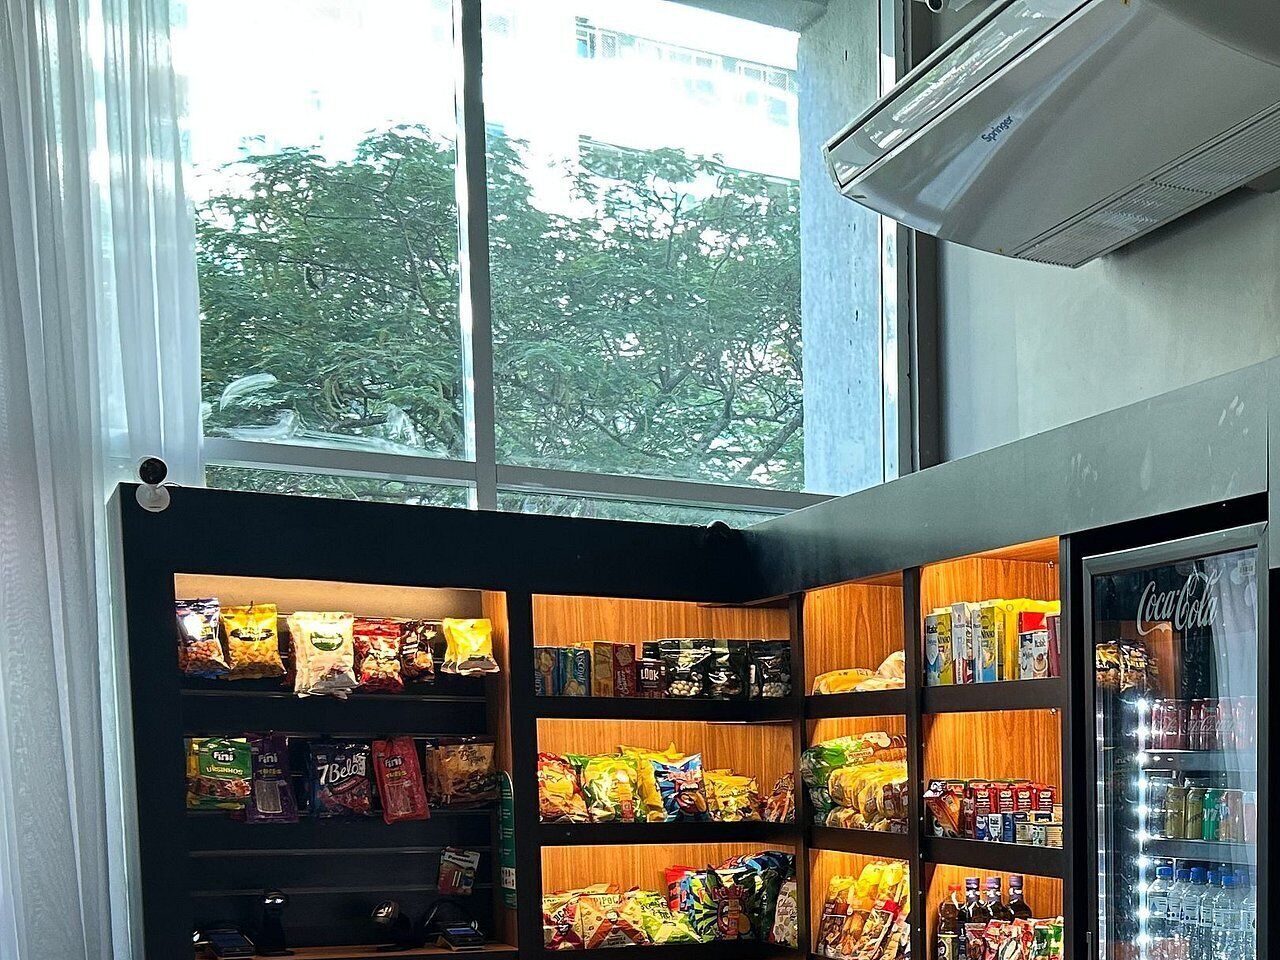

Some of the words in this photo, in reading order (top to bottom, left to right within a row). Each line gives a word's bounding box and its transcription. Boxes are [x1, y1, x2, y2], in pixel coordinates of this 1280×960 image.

[980, 115, 1015, 144] Springer
[1137, 568, 1223, 637] Coca-Cola
[213, 750, 234, 762] Fini
